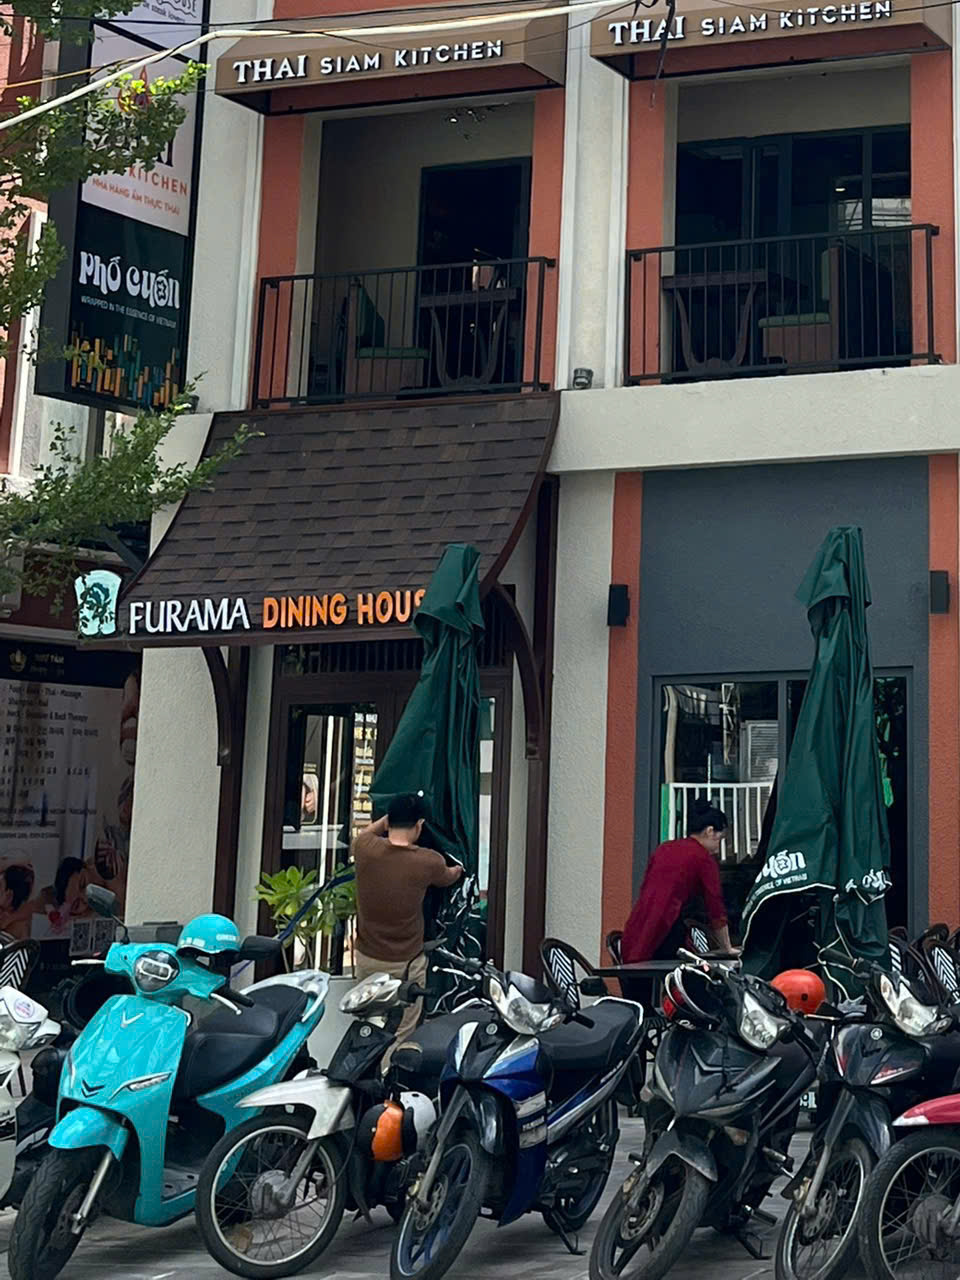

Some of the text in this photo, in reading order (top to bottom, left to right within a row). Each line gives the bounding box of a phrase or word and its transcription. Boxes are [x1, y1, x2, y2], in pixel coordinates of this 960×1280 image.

[608, 0, 893, 45] THAI SIAM KITCHEN
[232, 39, 504, 85] THAI SIAM KITCHEN
[129, 596, 251, 635] FURAMA
[262, 593, 347, 630] DINING
